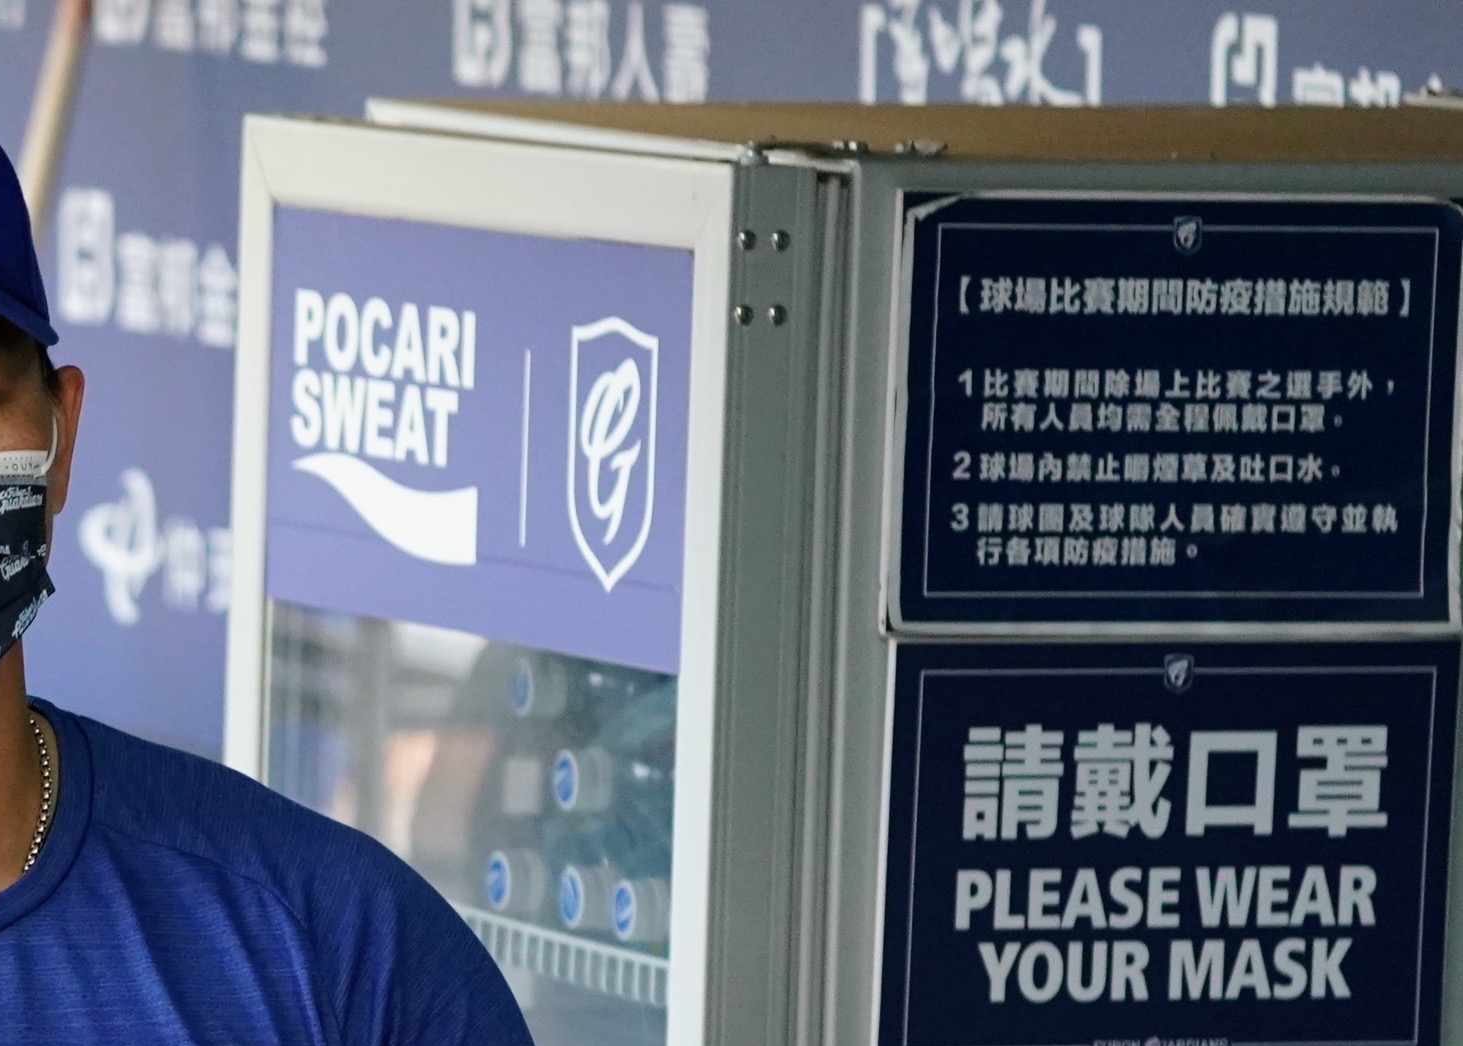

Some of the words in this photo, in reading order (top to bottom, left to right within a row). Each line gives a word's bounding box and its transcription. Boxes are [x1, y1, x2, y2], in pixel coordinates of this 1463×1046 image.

[293, 287, 477, 390] POCARI
[290, 368, 459, 469] SWEAT
[962, 723, 1389, 841] 請戴口罩
[954, 867, 1182, 931] PLEASE
[1196, 865, 1377, 927] WEAR
[978, 940, 1149, 1003] YOUR
[1168, 938, 1353, 1001] MASK
